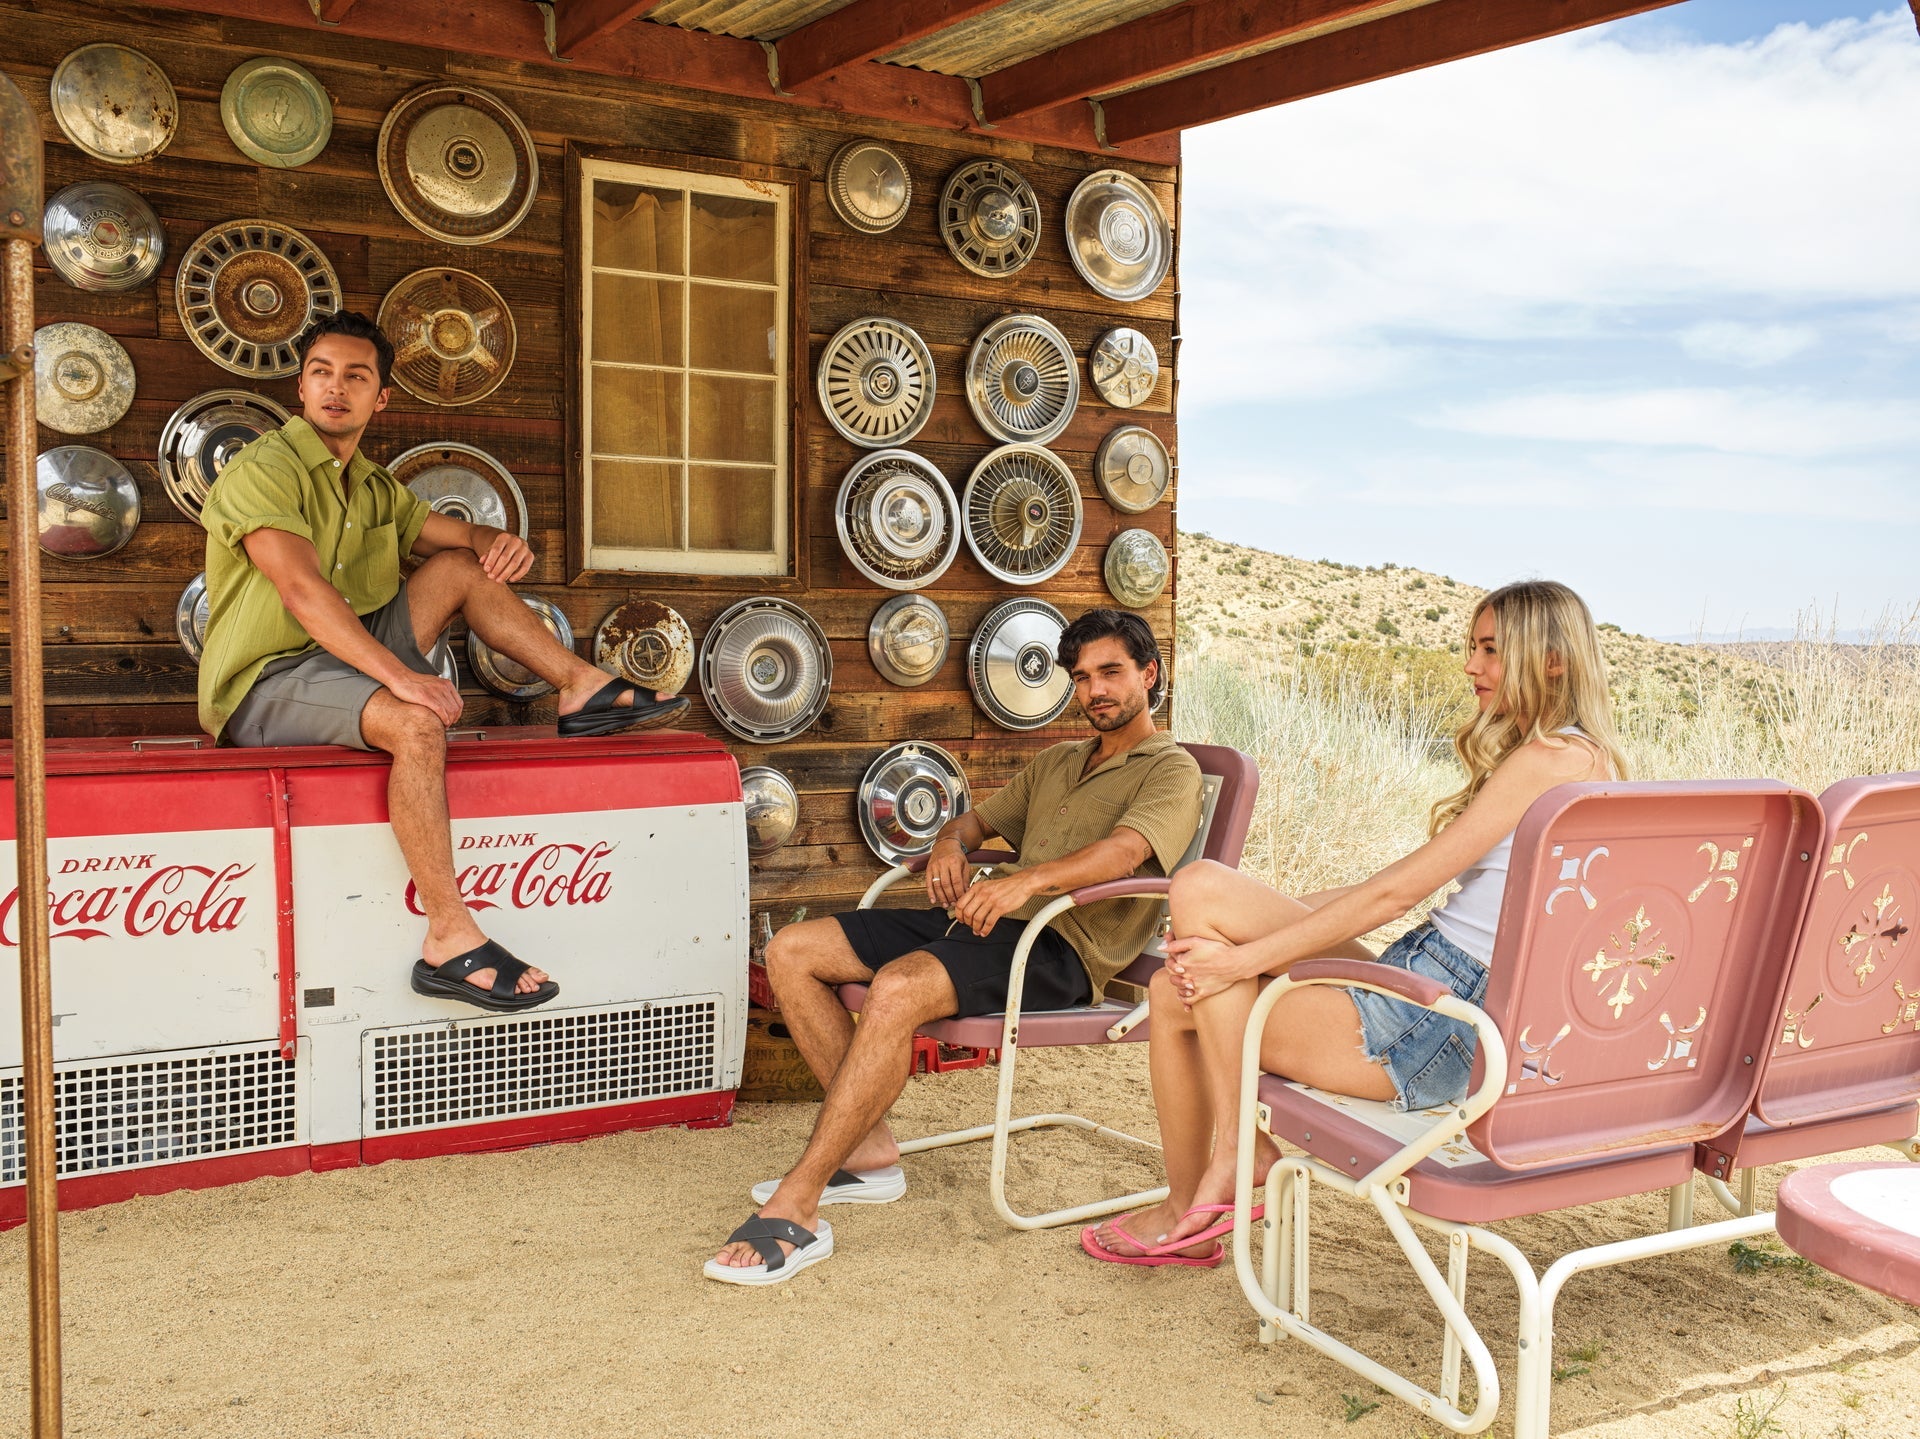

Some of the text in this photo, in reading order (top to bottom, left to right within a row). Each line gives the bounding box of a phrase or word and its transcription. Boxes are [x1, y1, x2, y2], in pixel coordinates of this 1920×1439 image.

[80, 210, 114, 232] PACKARD
[457, 832, 539, 850] DRINK
[57, 854, 157, 874] DRINK
